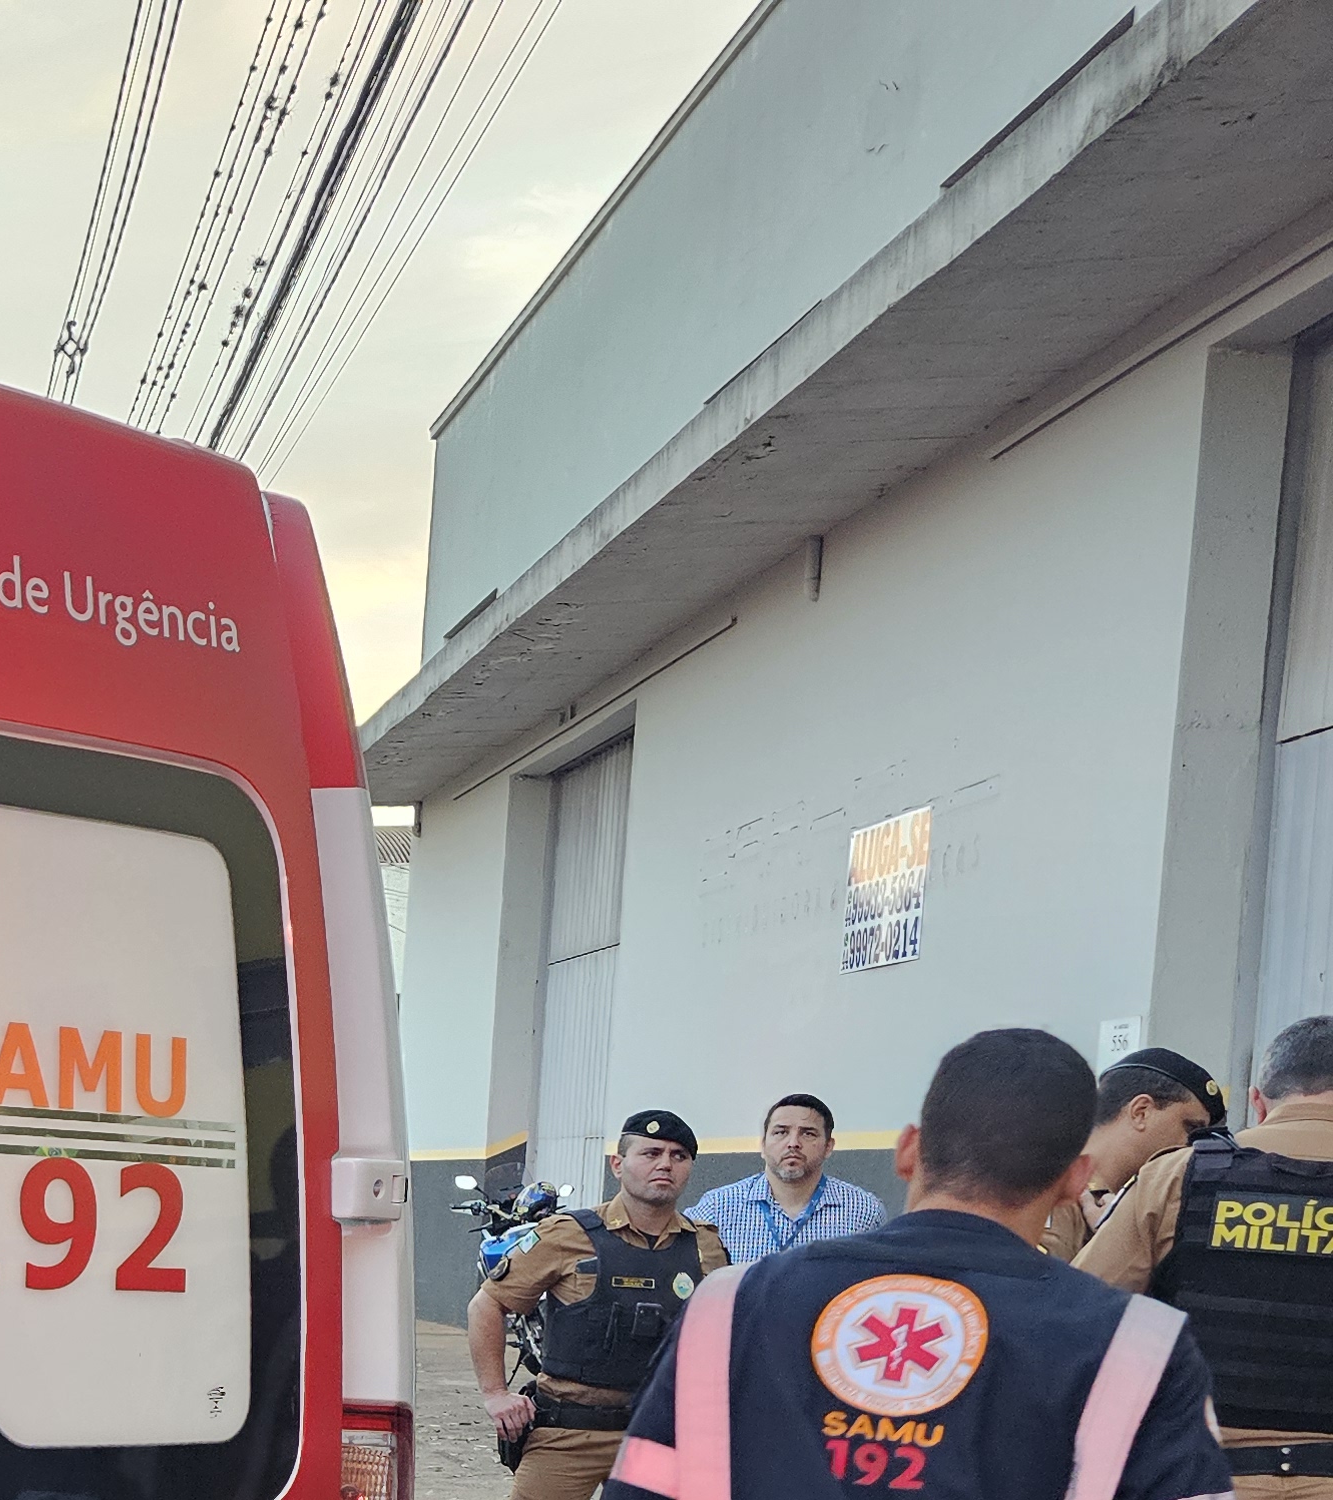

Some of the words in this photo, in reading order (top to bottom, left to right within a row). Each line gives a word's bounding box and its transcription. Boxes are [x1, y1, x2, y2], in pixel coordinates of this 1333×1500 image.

[63, 570, 241, 653] Urgência
[849, 810, 931, 885] ALUGA-SE
[848, 915, 920, 970] 99972-0214
[821, 1409, 945, 1448] SAMU
[825, 1439, 927, 1491] 192
